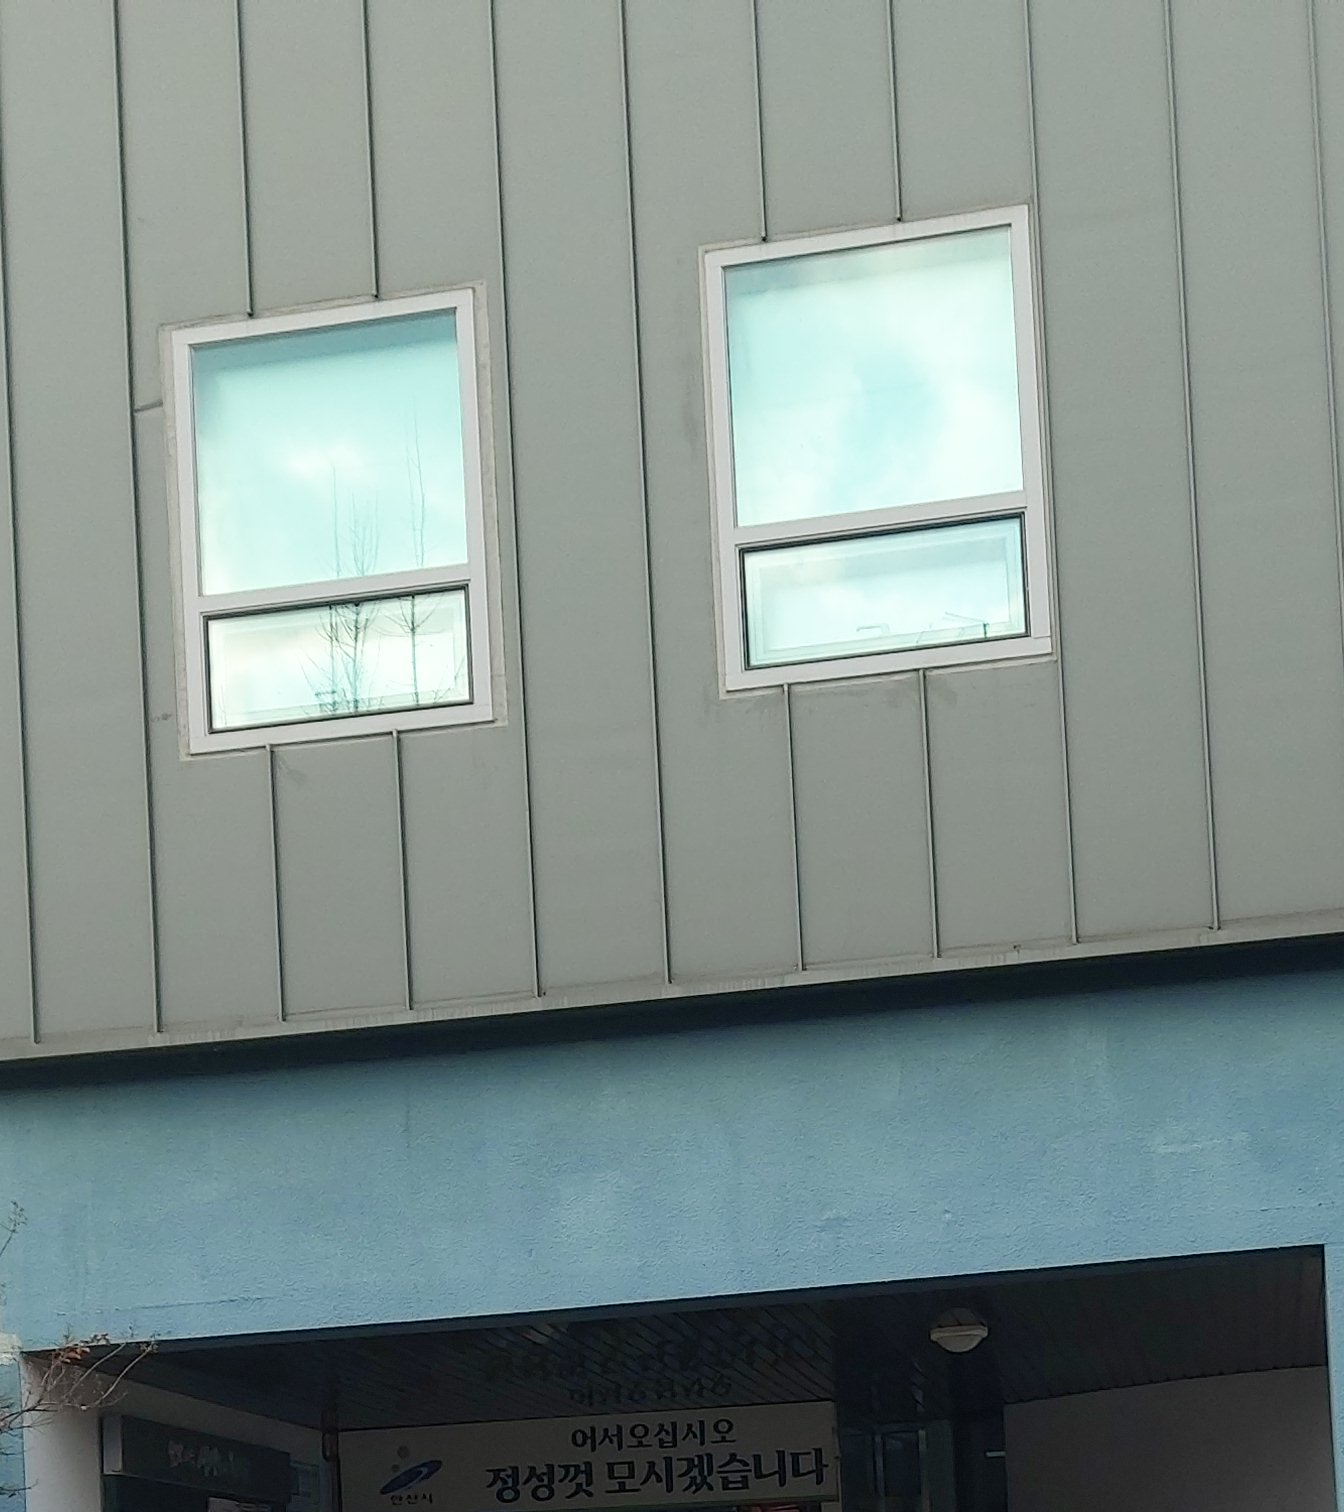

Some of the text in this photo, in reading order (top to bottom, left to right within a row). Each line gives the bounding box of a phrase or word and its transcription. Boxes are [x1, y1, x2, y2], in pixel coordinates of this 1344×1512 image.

[570, 1418, 737, 1452] 어서오십시오
[485, 1447, 830, 1504] 정성껏 모시겠습니다
[389, 1493, 434, 1506] 안산시
